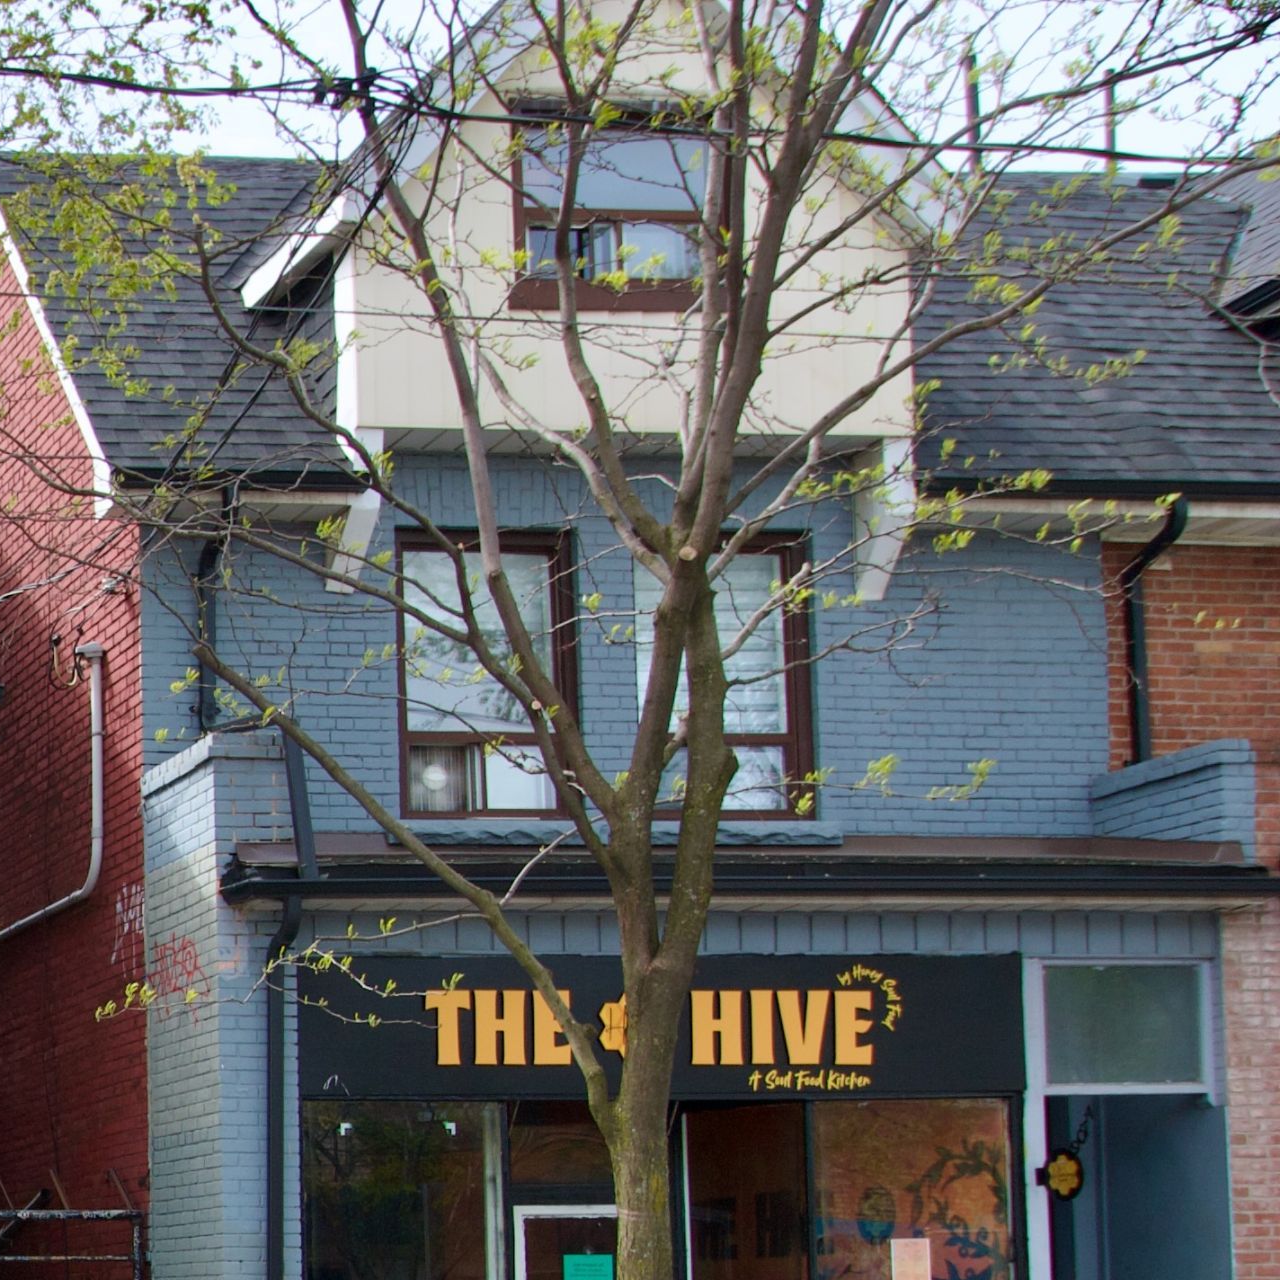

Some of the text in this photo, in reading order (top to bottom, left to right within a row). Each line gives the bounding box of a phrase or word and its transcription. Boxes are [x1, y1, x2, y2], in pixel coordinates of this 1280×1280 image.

[836, 971, 851, 986] by
[853, 964, 883, 983] Honey
[425, 989, 874, 1066] THE HIVE
[749, 1069, 871, 1091] A Soul Food Kitchen
